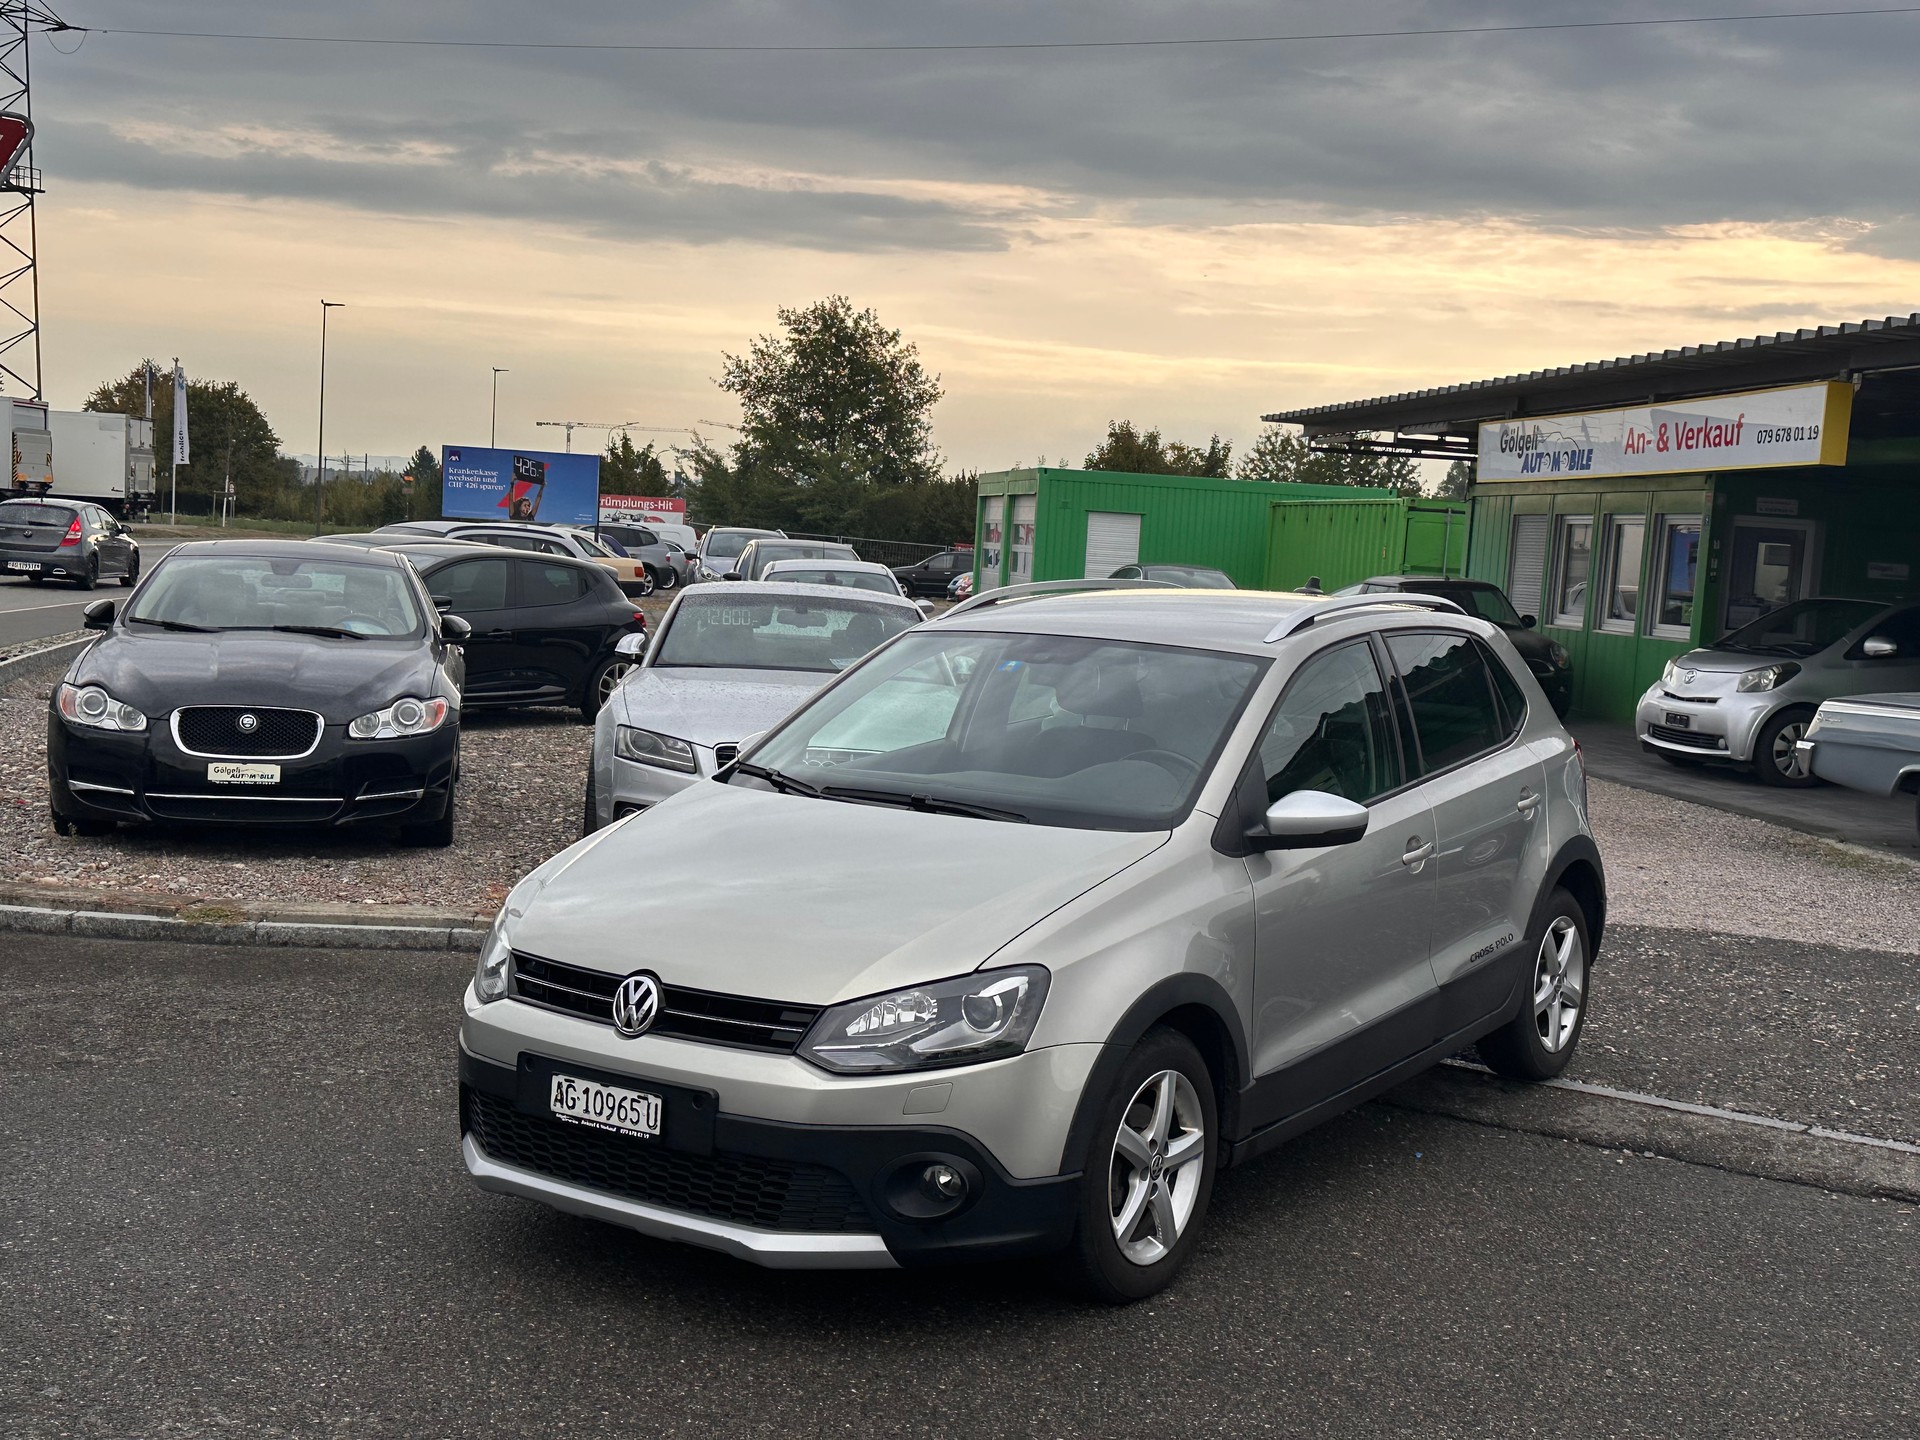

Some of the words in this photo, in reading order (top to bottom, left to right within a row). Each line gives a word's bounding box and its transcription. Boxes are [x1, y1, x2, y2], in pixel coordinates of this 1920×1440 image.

[1501, 425, 1539, 459] Gölgeli
[1625, 427, 1652, 455] An-
[1656, 422, 1669, 453] &
[1675, 413, 1745, 450] Verkauf
[1757, 429, 1773, 444] 079
[1775, 428, 1792, 443] 678
[1793, 427, 1805, 441] 01
[1807, 425, 1819, 440] 19
[448, 467, 499, 477] Krankenkasse
[1521, 449, 1593, 473] AUTOMOBILE
[213, 766, 241, 776] Gölgeli
[1470, 944, 1494, 963] CROSS
[1495, 933, 1514, 949] POLO
